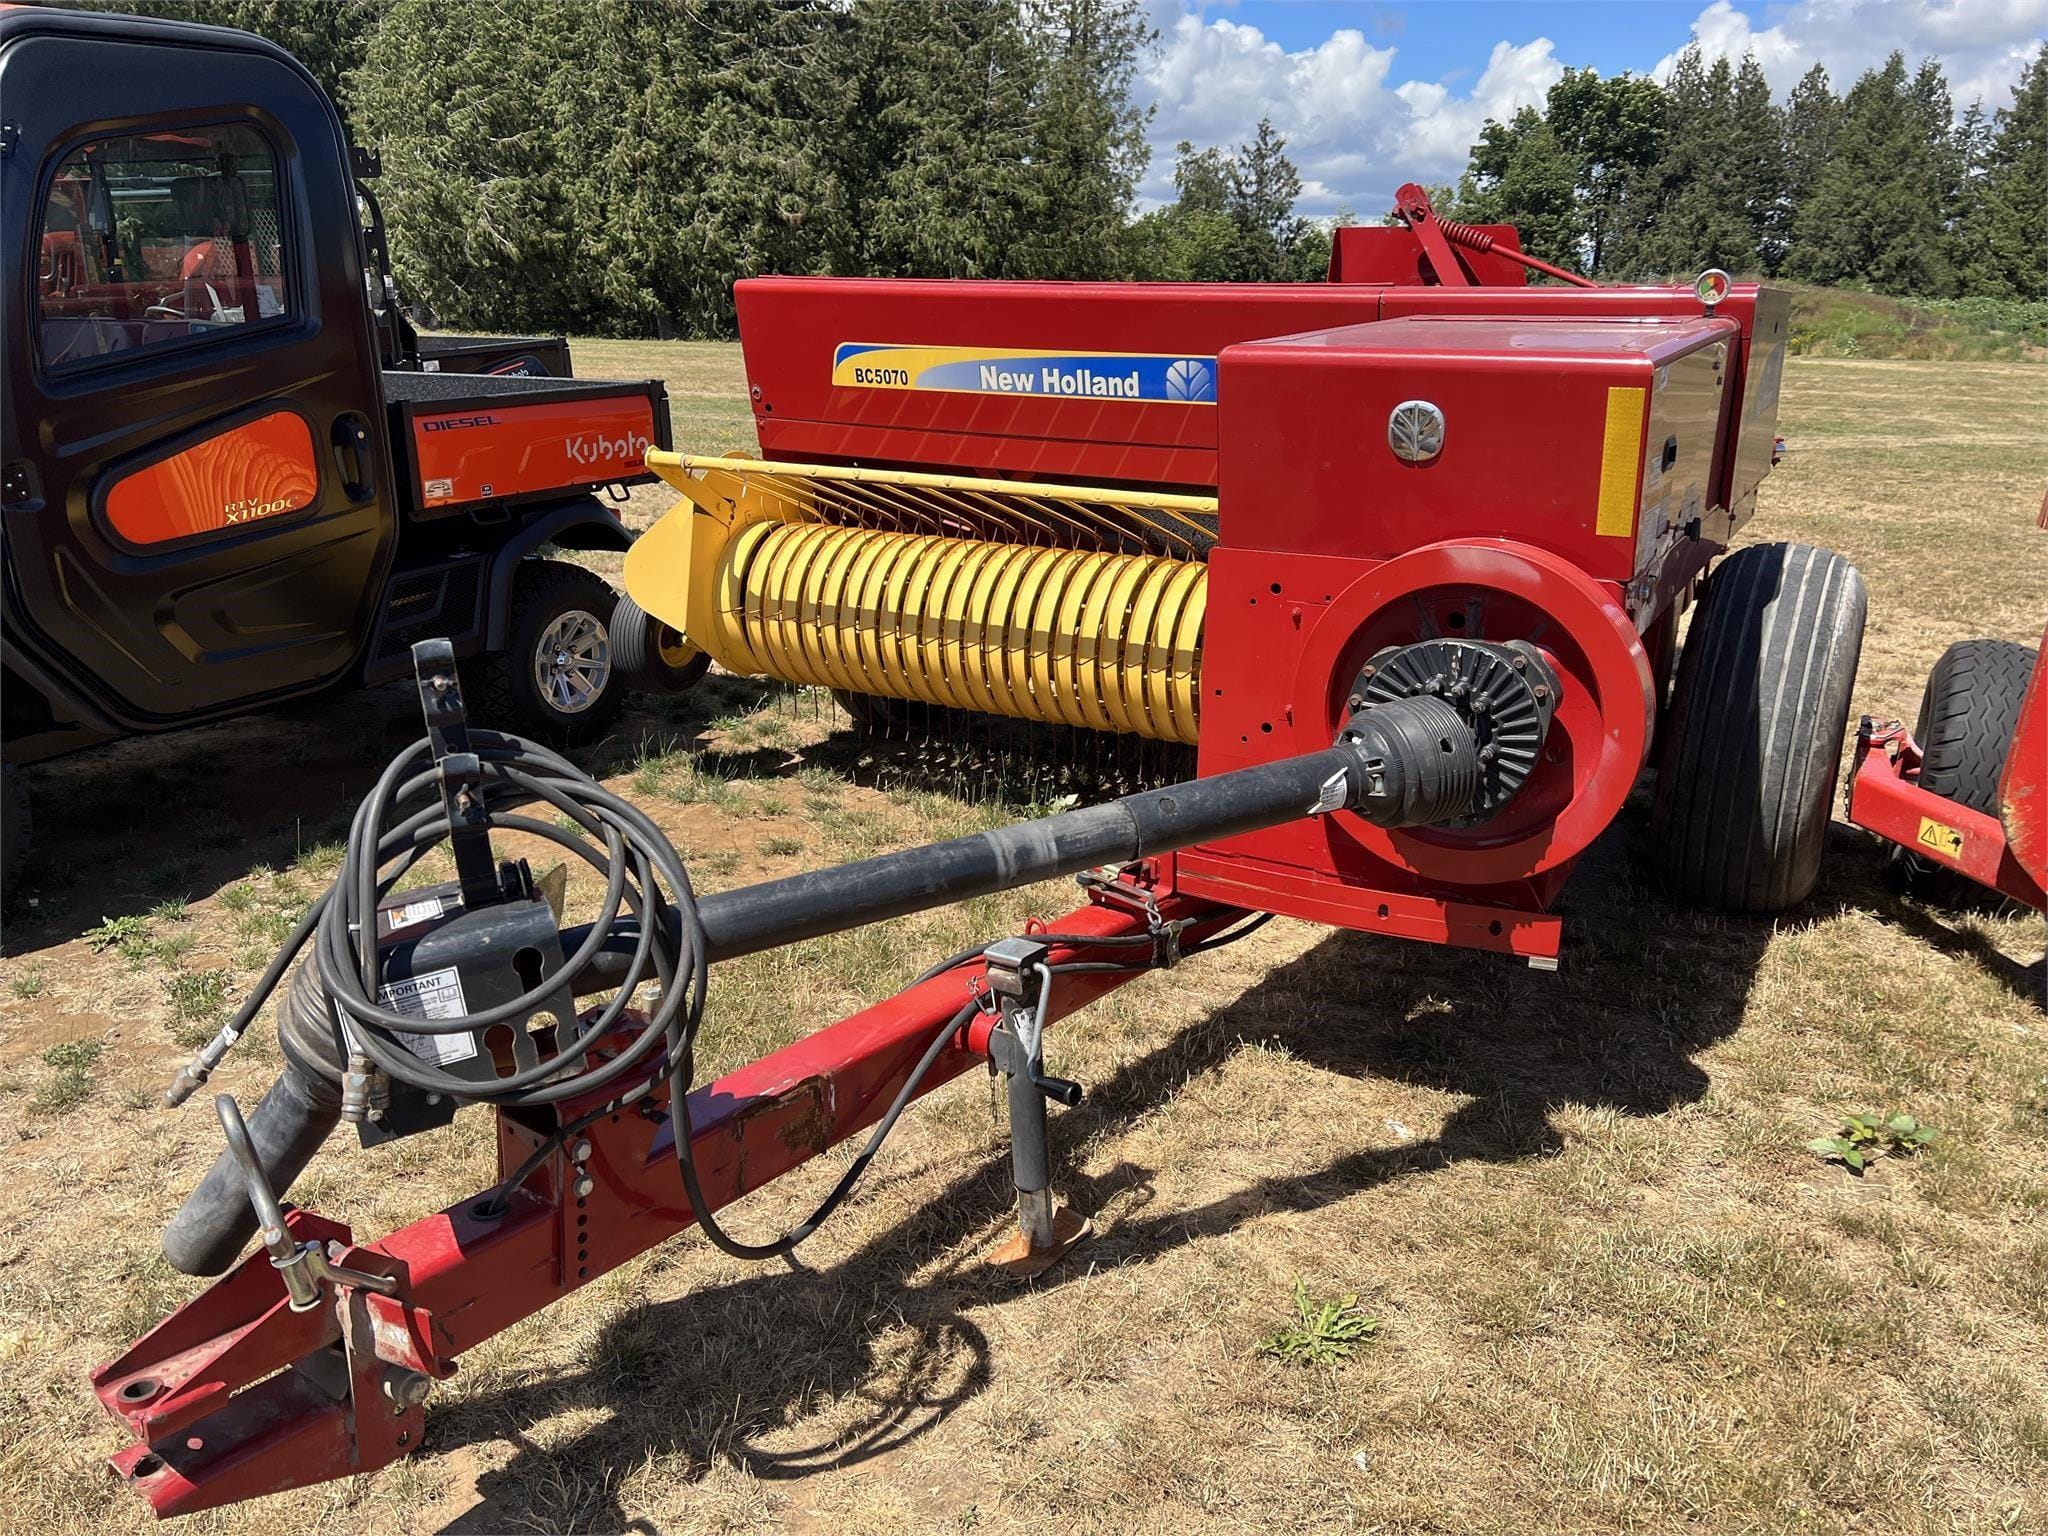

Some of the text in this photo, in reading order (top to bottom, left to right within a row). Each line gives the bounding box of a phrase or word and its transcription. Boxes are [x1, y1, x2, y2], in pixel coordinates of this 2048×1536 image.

[855, 368, 908, 386] BC5070
[979, 365, 1140, 397] New Holland
[423, 415, 502, 432] DIESEL
[565, 431, 649, 464] Kubota
[225, 498, 258, 513] RTV
[377, 976, 442, 1001] MPORTANT
